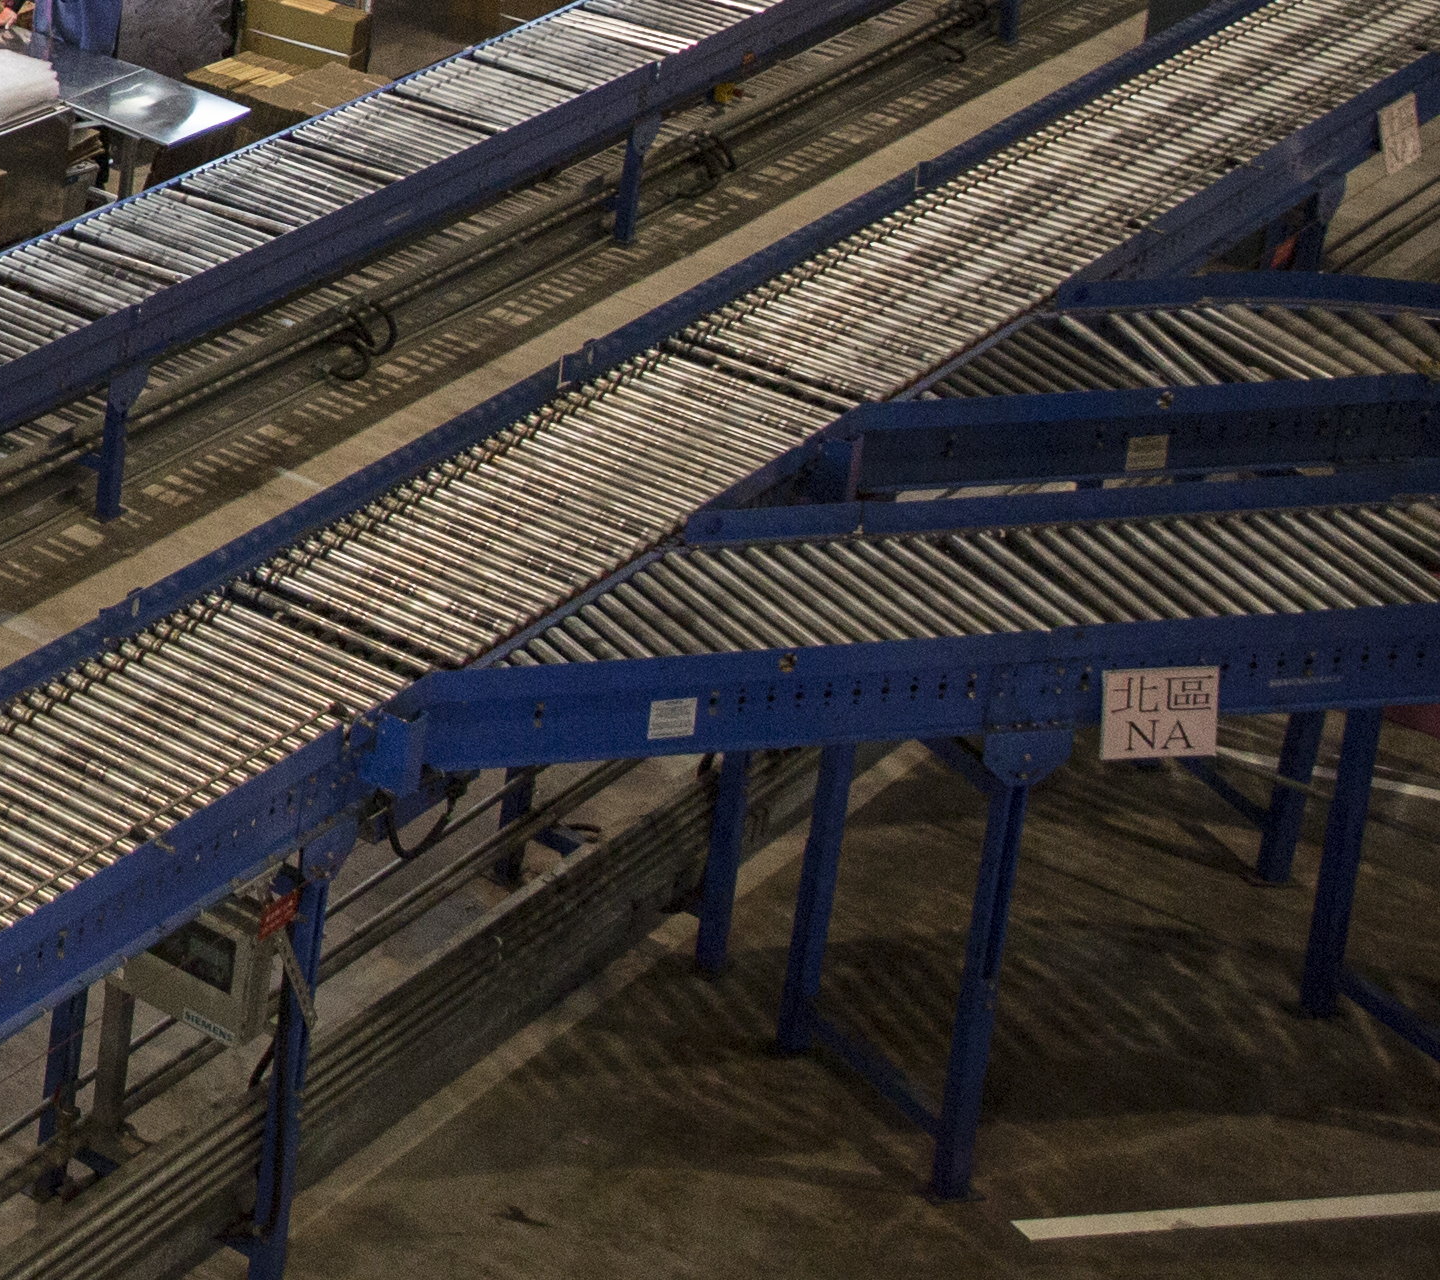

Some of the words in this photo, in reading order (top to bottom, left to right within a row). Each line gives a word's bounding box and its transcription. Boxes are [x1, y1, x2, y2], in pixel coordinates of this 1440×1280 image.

[1111, 674, 1214, 715] 北區
[1125, 719, 1195, 752] NA
[184, 1010, 234, 1042] SIEMENS
